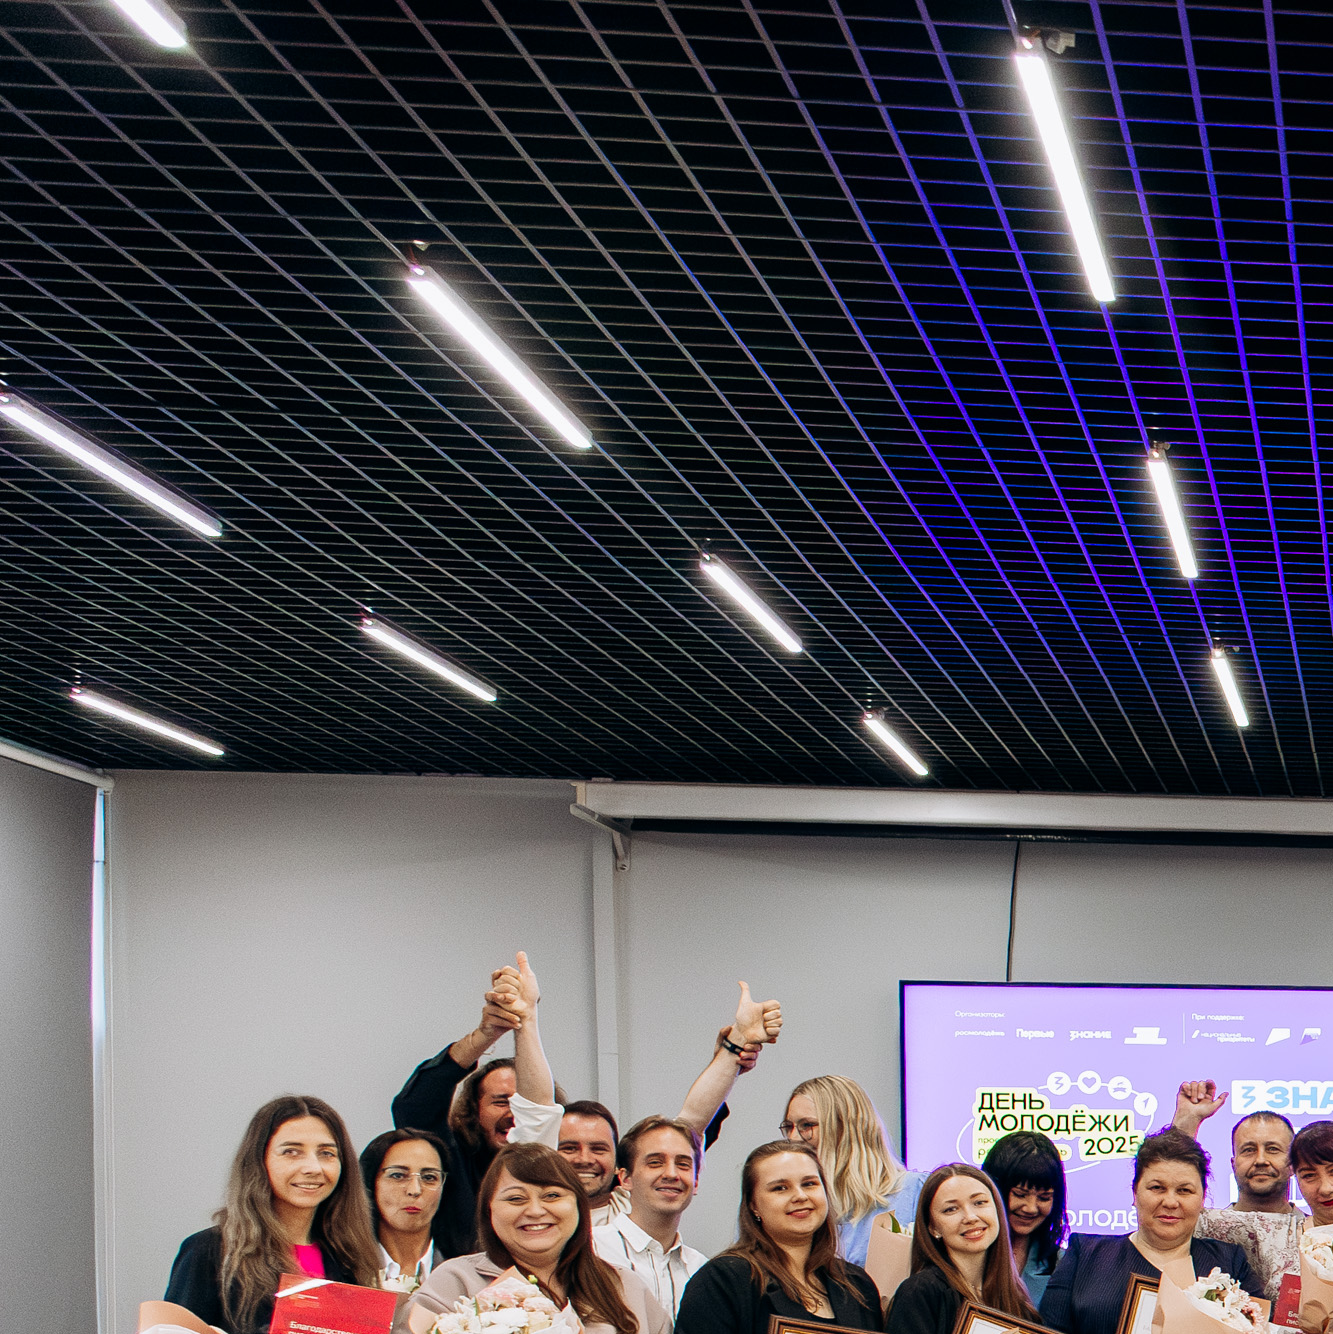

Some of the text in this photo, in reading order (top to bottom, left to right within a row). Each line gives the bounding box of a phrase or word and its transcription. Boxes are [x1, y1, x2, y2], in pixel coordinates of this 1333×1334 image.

[1016, 1028, 1055, 1040] Первые
[978, 1093, 1045, 1113] ДЕНЬ
[978, 1110, 1129, 1135] МОЛОДЁЖИ
[1084, 1135, 1140, 1156] 2025
[1066, 1208, 1138, 1230] олодё
